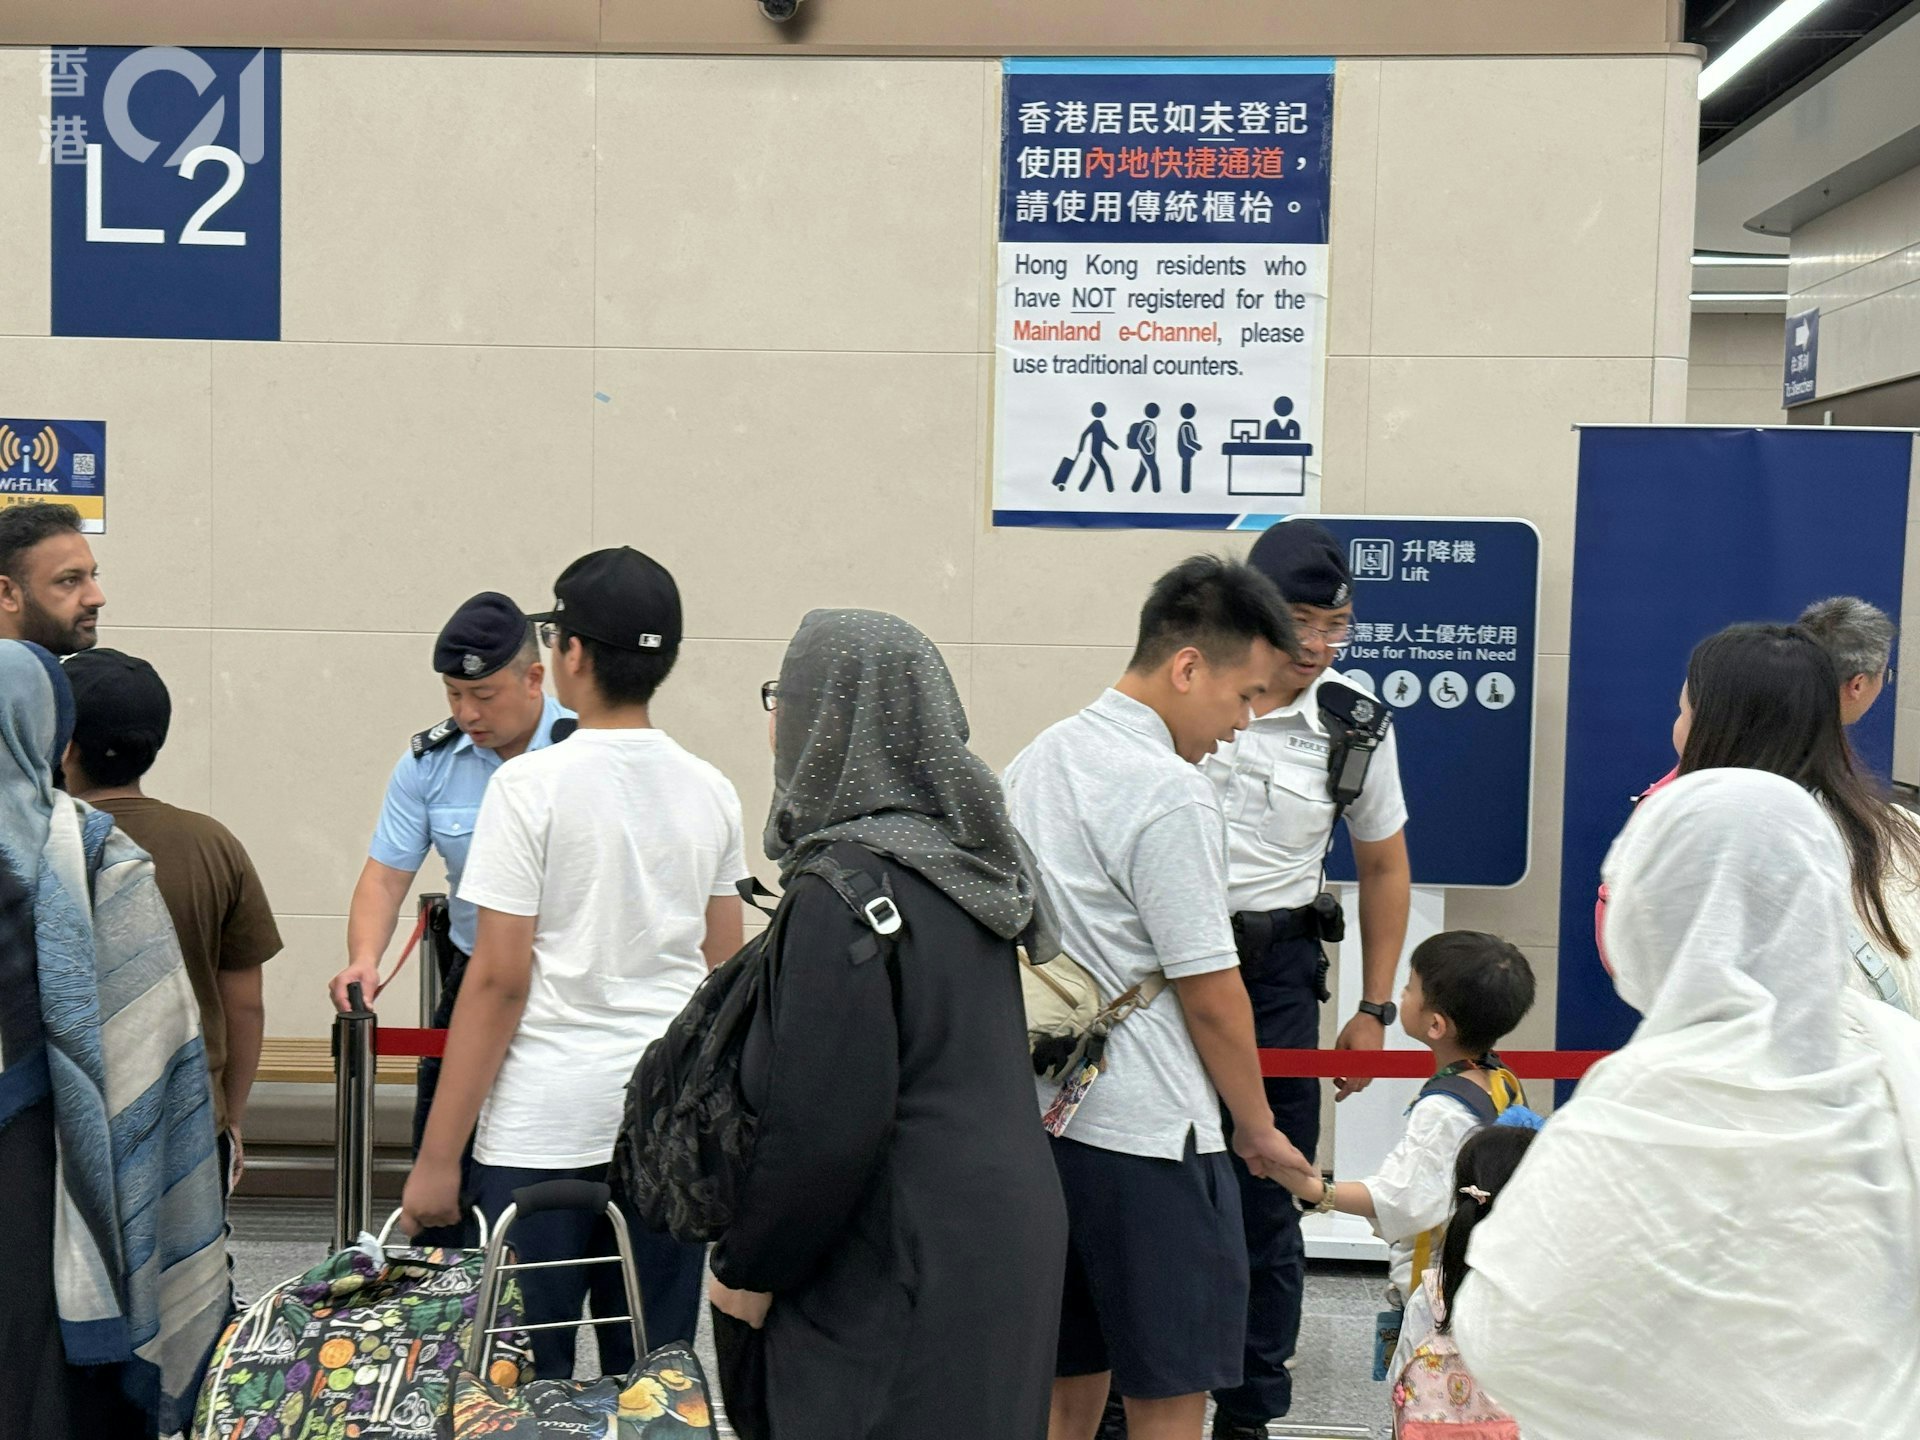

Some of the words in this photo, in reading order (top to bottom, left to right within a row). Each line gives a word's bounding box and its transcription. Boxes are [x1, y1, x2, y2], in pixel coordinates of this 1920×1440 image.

[1018, 101, 1308, 135] 香港居民如未登記
[86, 143, 247, 246] L2
[1016, 190, 1301, 223] 請使用傳統櫃枱。
[1015, 253, 1067, 280] Hong
[1086, 254, 1138, 280] Kong
[1157, 254, 1246, 276] residents
[1264, 255, 1307, 276] who
[1014, 287, 1061, 308] have
[1072, 287, 1116, 308] NOT
[1127, 288, 1225, 313] registered
[1236, 289, 1264, 309] for
[1275, 289, 1306, 309] the
[1013, 320, 1101, 341] Mainland
[1119, 321, 1222, 346] e-Channel,
[1241, 322, 1304, 347] please
[1013, 357, 1048, 374] use
[1053, 354, 1148, 375] traditional
[1153, 357, 1243, 376] counters.
[1402, 540, 1476, 563] 升降機
[1402, 567, 1429, 582] Lift
[1351, 646, 1379, 659] Use
[1382, 646, 1405, 659] for
[1408, 647, 1454, 660] Those
[1457, 648, 1472, 660] in
[1476, 648, 1516, 661] Need
